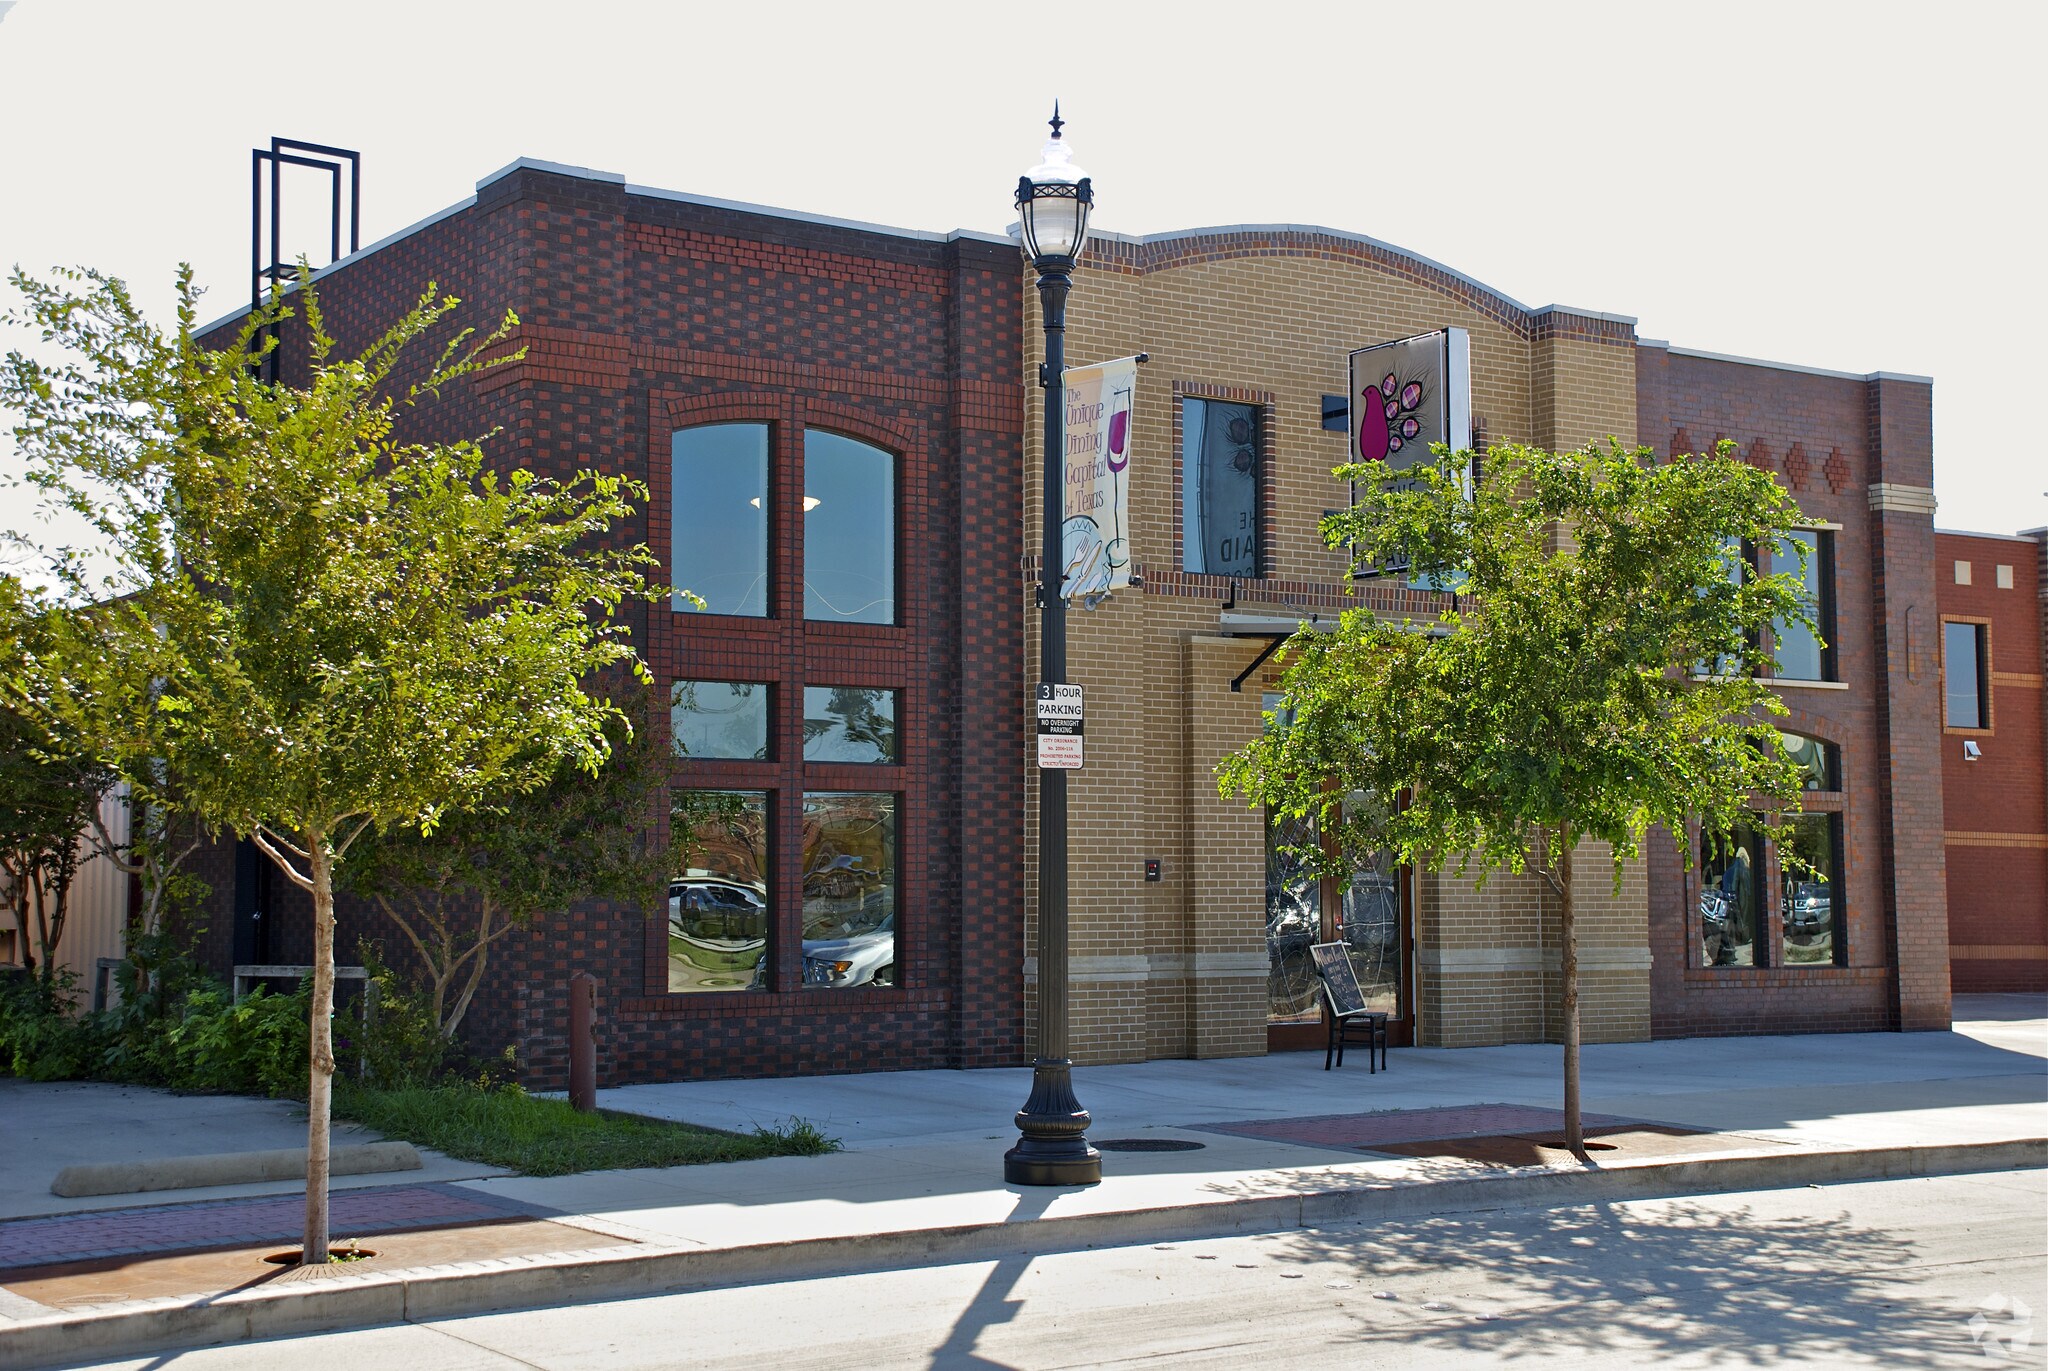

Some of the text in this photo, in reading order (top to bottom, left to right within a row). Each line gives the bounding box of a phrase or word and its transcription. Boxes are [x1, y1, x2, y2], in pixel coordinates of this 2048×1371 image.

[1066, 388, 1081, 403] The
[1066, 402, 1104, 427] Unique
[1065, 431, 1103, 456] Dining
[1066, 454, 1106, 488] Capital
[1065, 489, 1104, 514] of Texas
[1043, 685, 1081, 698] 3 HOUR
[1039, 704, 1081, 715] PARKING
[1050, 719, 1080, 727] OVERNIGHT
[1050, 726, 1073, 734] PARKING
